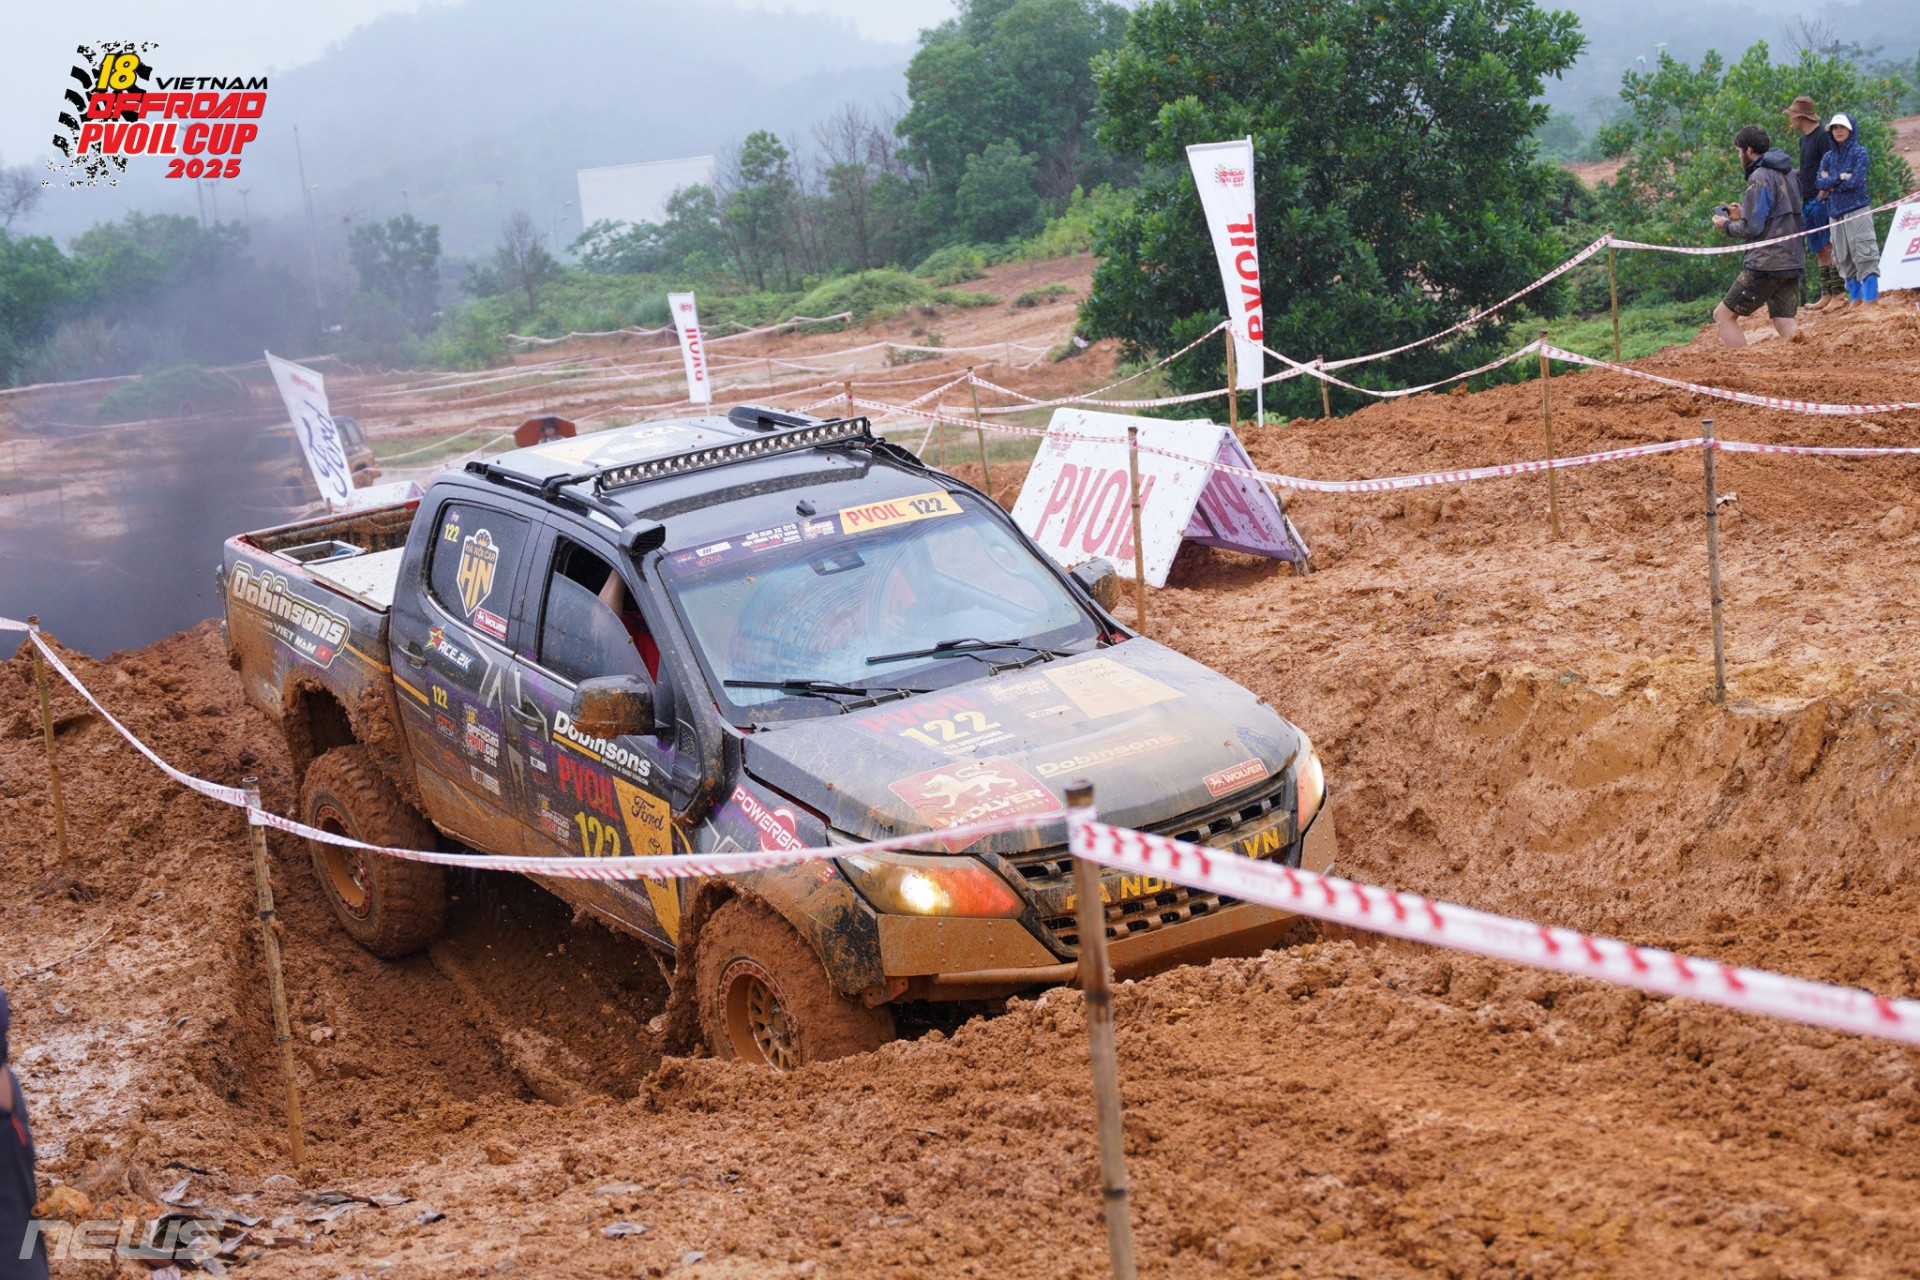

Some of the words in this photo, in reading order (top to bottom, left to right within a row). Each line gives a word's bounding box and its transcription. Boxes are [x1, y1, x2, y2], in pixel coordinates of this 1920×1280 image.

[1226, 213, 1264, 341] PVOIL
[300, 399, 348, 499] Ford
[845, 503, 906, 527] PVOIL
[908, 497, 947, 515] 122
[444, 523, 459, 542] 122
[459, 553, 494, 610] HN
[432, 684, 448, 710] 122
[858, 694, 985, 734] PVOIL
[899, 711, 1002, 747] 122
[485, 743, 499, 760] CUP
[1035, 734, 1175, 776] Dobinsons
[557, 752, 619, 820] PVOIL
[1222, 763, 1264, 783] WOLVER
[631, 795, 665, 831] Ford
[1242, 827, 1280, 860] VN
